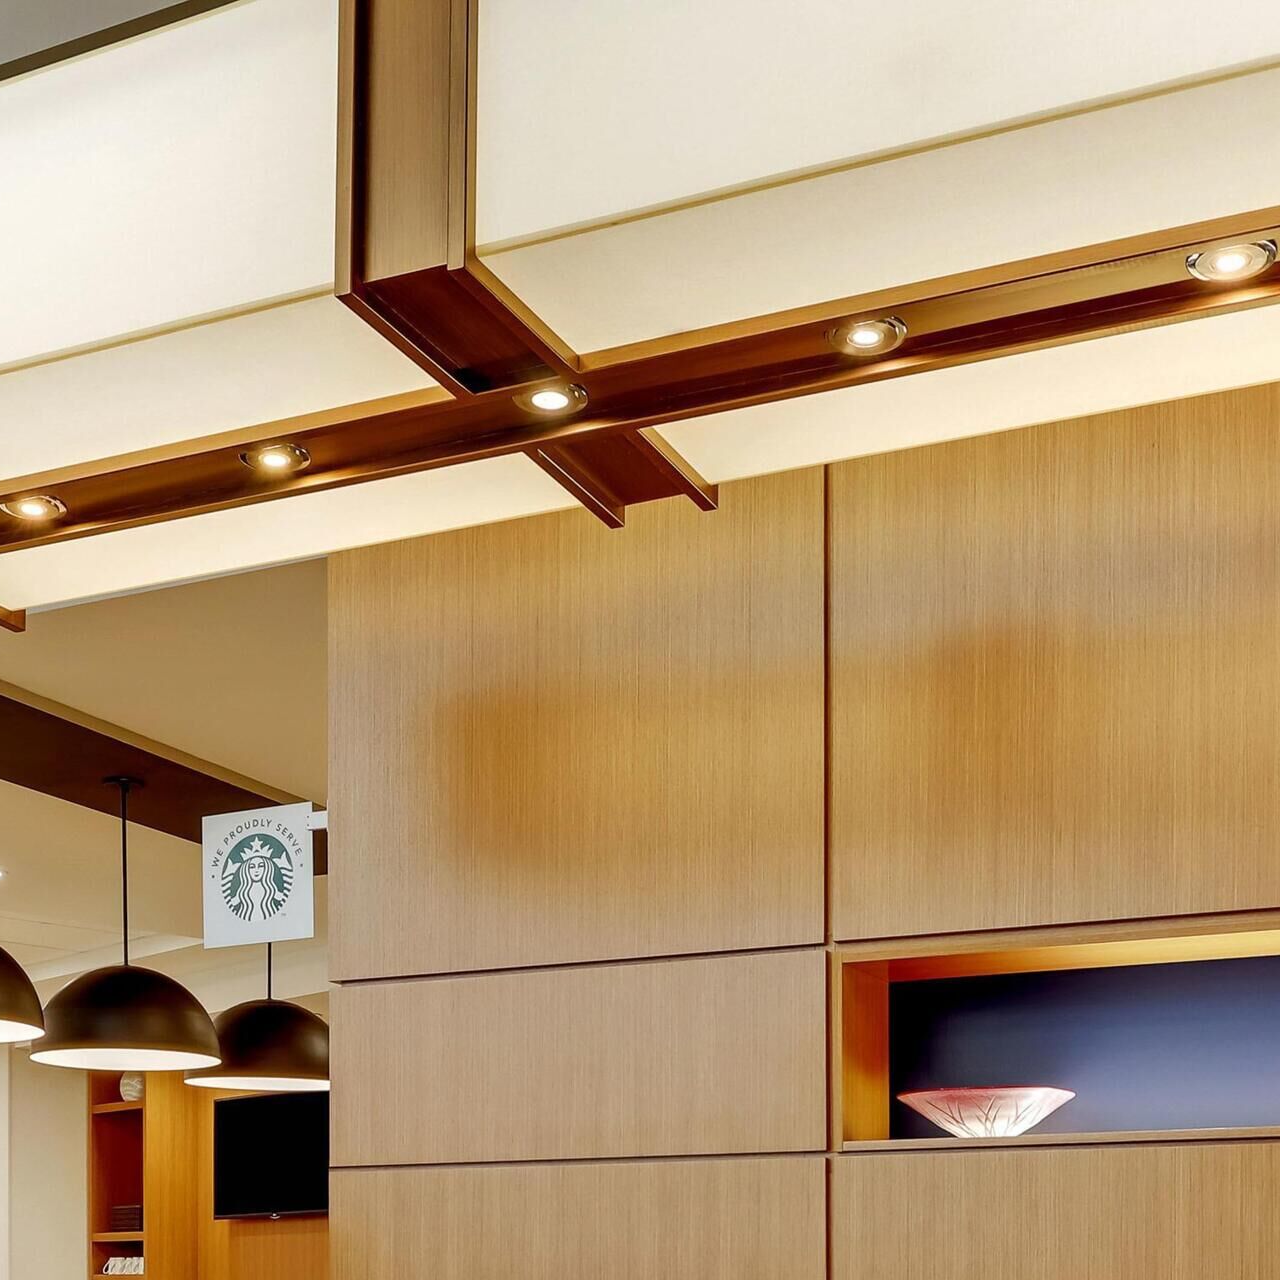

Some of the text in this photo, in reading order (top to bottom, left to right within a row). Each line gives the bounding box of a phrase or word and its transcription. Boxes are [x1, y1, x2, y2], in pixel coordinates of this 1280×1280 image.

[211, 818, 302, 868] WE PROUDLY SERVE
